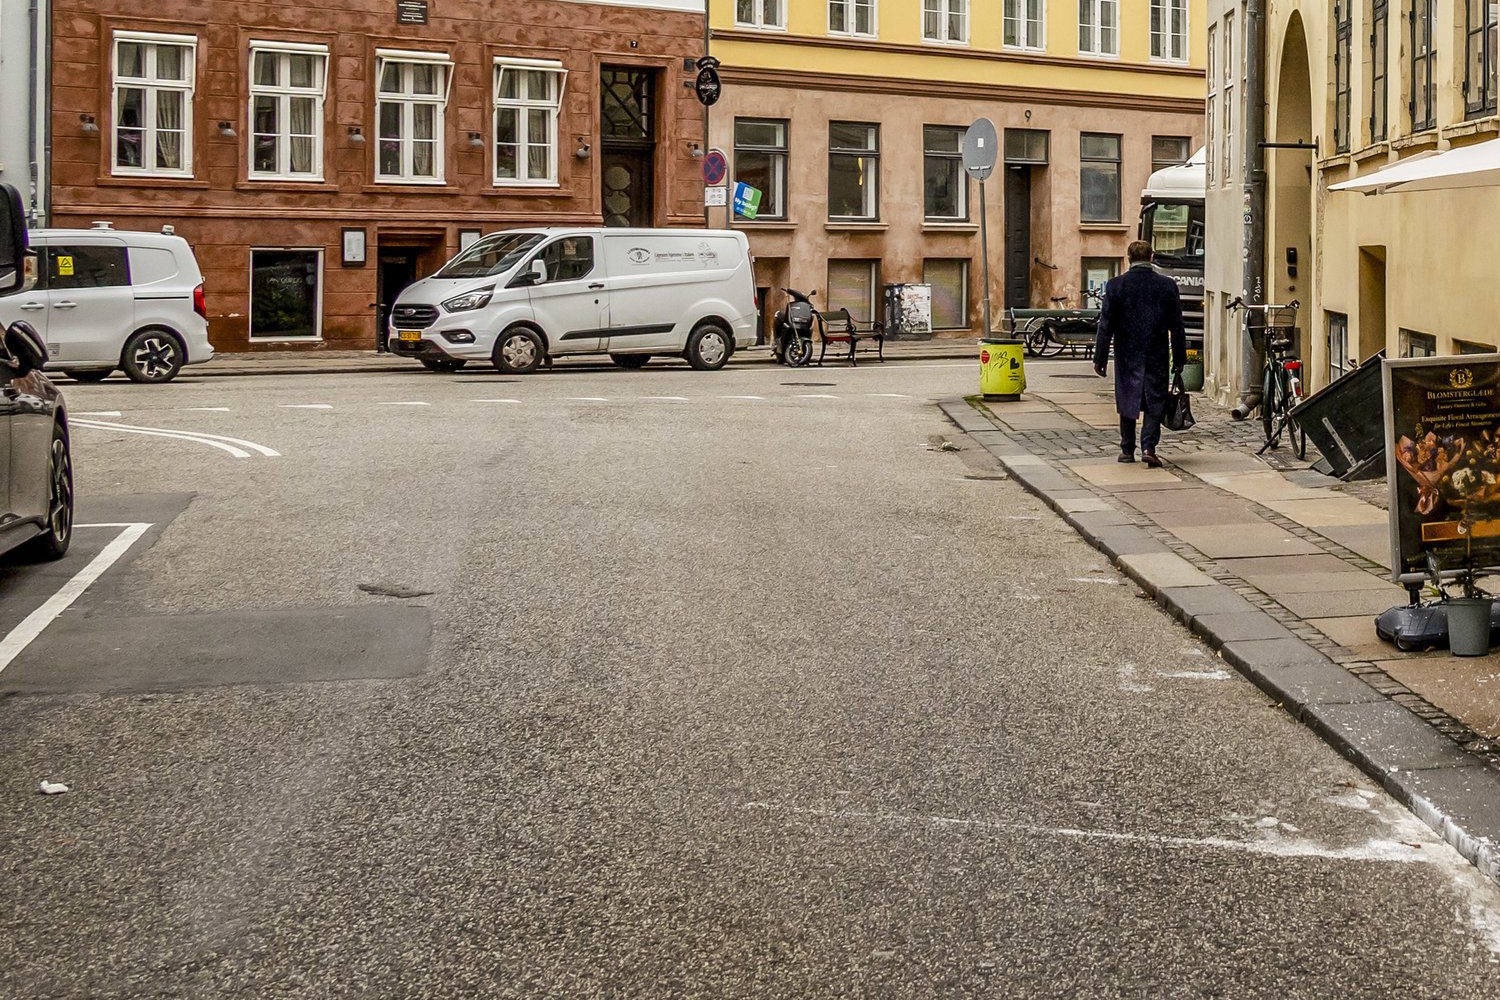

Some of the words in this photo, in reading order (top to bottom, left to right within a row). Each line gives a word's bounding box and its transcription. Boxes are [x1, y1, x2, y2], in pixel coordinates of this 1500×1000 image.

[1024, 109, 1032, 122] 9
[1167, 275, 1205, 287] CANIA
[1457, 373, 1467, 384] B
[1427, 390, 1494, 399] BLOMSTERGLÆDE
[1447, 413, 1465, 421] Floral
